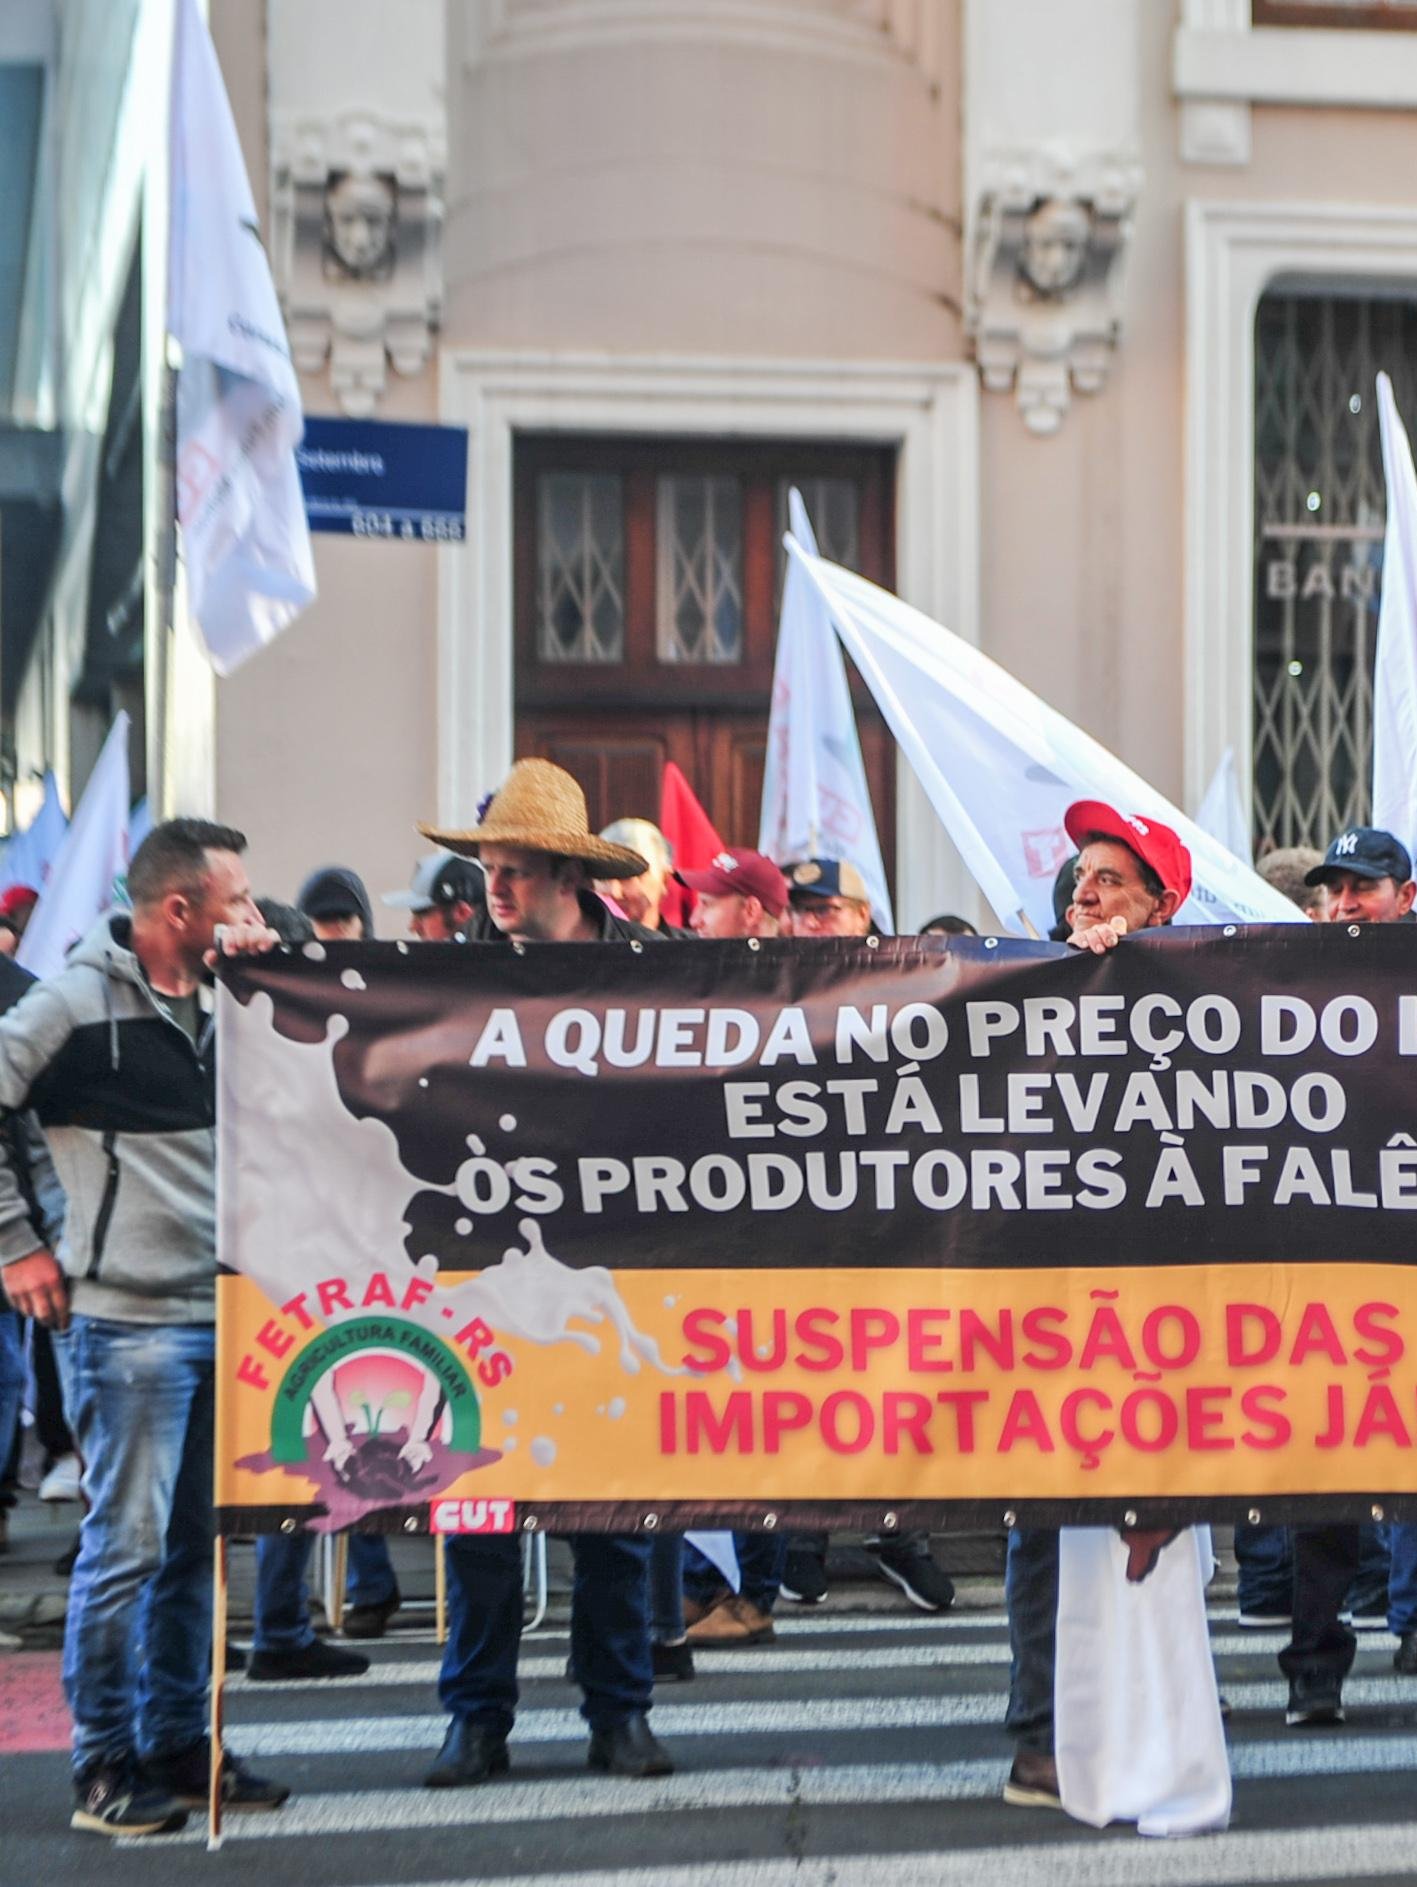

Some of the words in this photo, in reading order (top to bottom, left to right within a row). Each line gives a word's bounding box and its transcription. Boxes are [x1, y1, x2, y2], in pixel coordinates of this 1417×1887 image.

[469, 1007, 527, 1067] A
[545, 1006, 817, 1076] QUEDA
[835, 1002, 949, 1062] NO
[966, 993, 1241, 1072] PREÇO
[1261, 993, 1378, 1056] DO
[724, 1061, 944, 1138] ESTÁ
[959, 1069, 1346, 1134] LEVANDO
[578, 1149, 1127, 1213] PRODUTORES
[1145, 1131, 1206, 1208] À
[284, 1323, 395, 1402] AGRICULTURA
[399, 1329, 468, 1398] FAMILIAR
[682, 1288, 1202, 1373] SUSPENSÃO
[1225, 1301, 1405, 1368] DAS
[660, 1371, 1292, 1470] IMPORTAÇÕES
[434, 1501, 511, 1530] CUT
